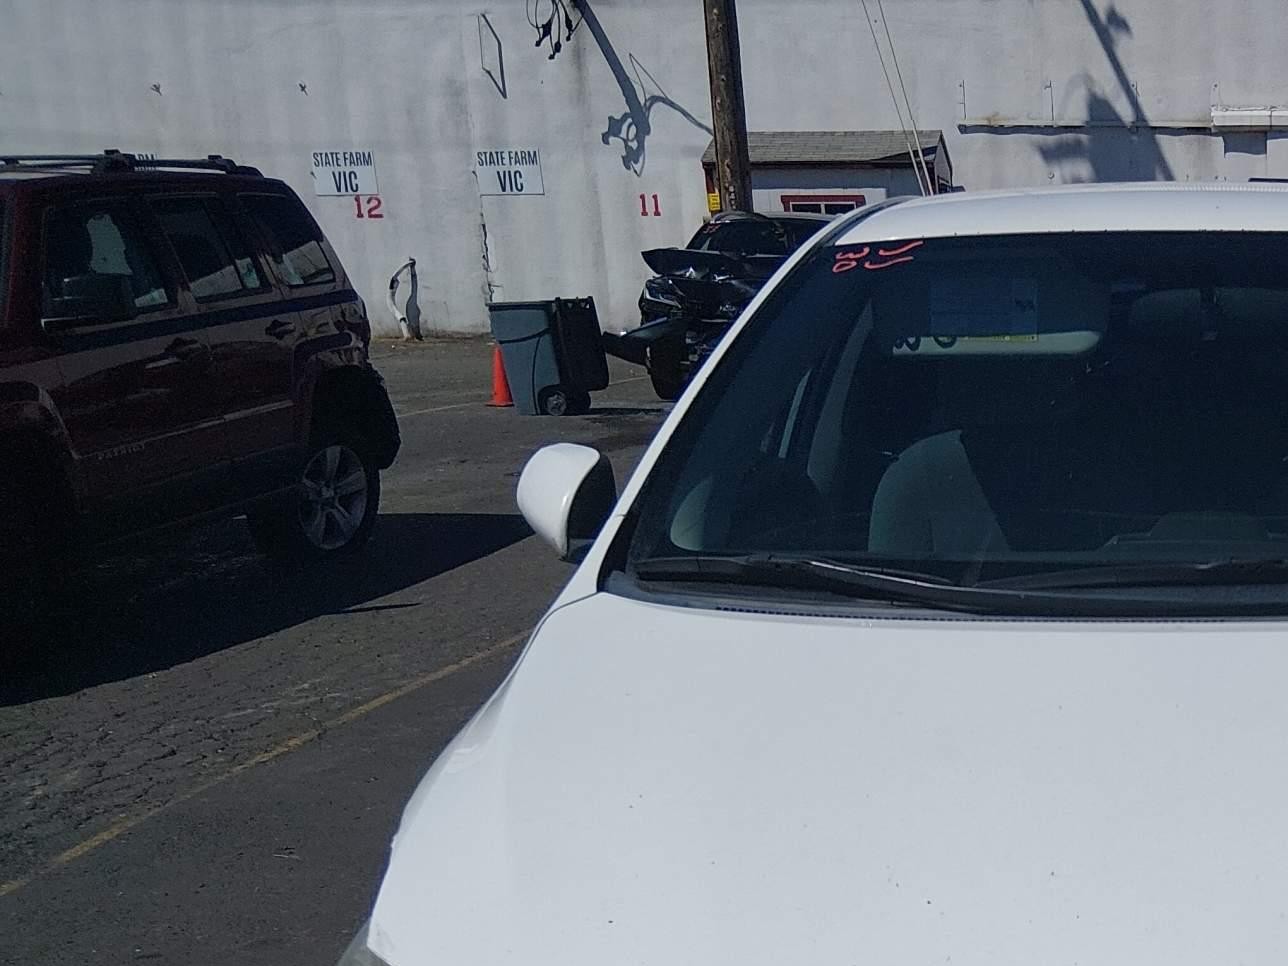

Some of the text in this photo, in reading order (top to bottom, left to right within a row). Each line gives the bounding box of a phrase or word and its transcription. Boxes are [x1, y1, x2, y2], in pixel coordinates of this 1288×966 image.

[313, 151, 372, 167] STATE FARM
[477, 150, 538, 167] STATE FARM
[332, 170, 359, 193] VIC
[497, 170, 524, 193] VIC
[354, 194, 384, 219] 12
[639, 192, 662, 218] 11
